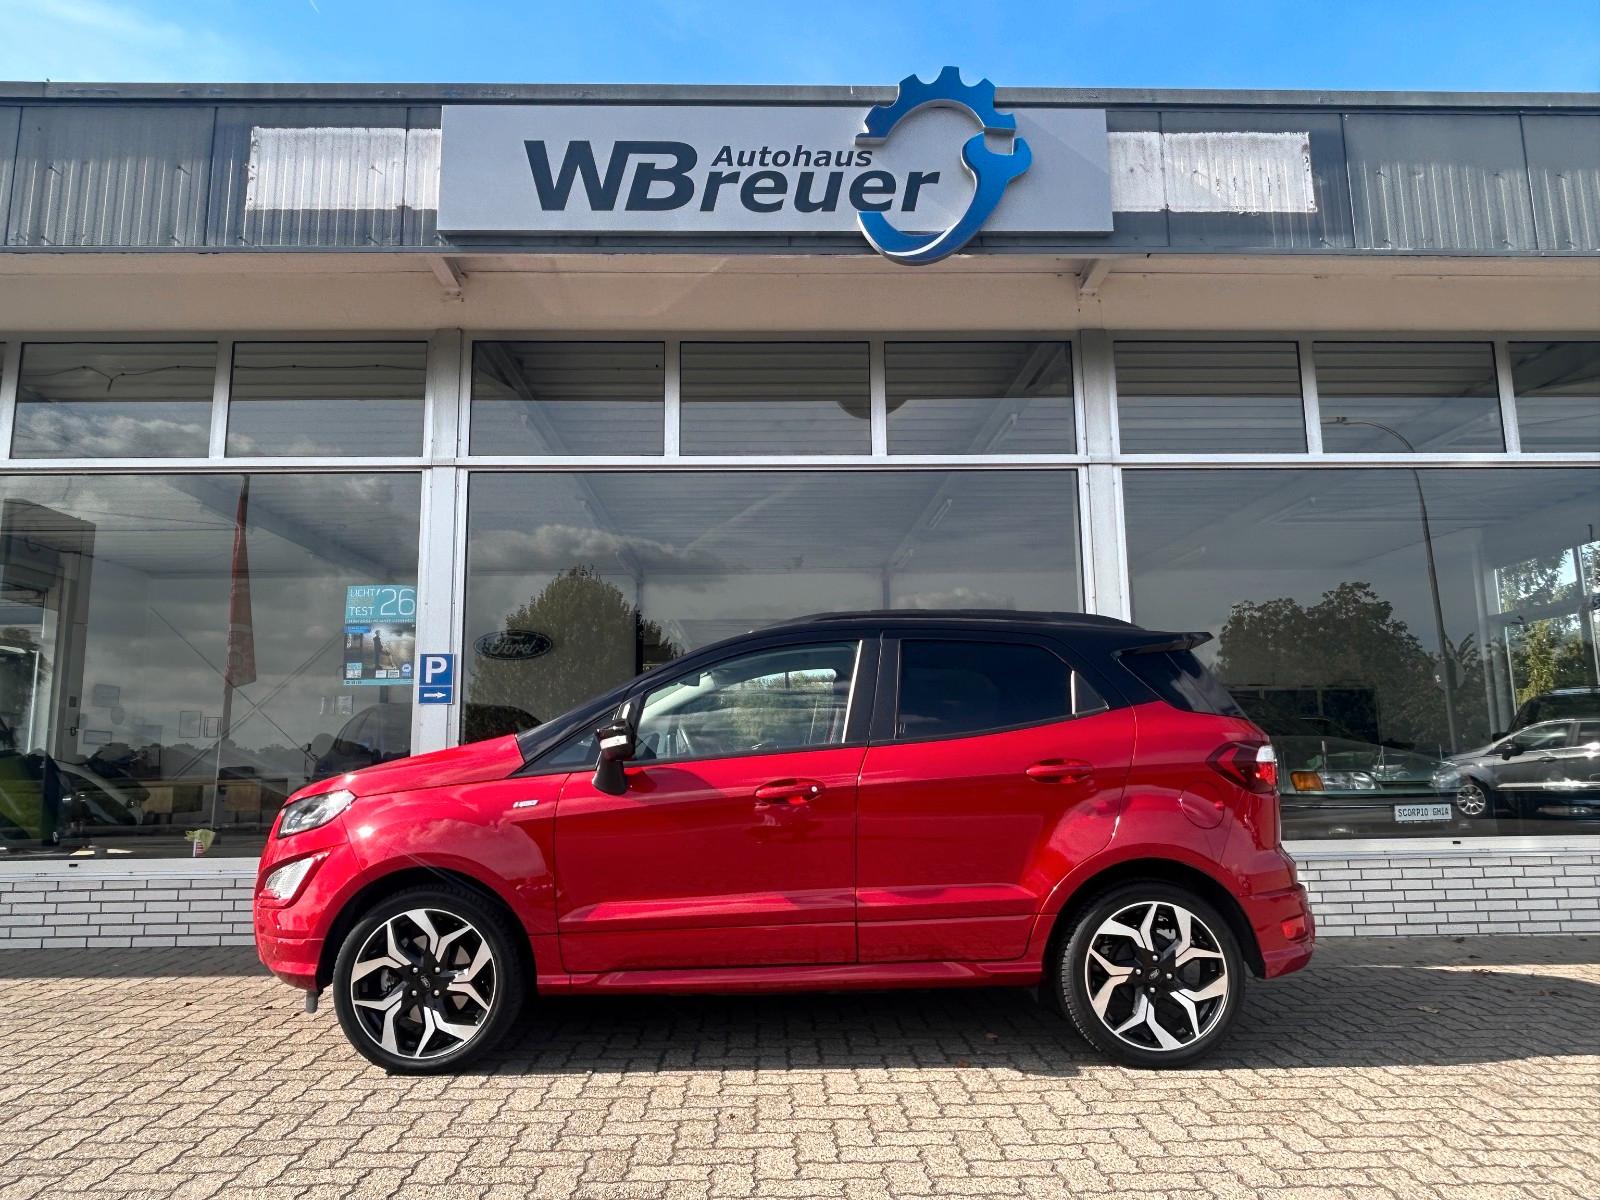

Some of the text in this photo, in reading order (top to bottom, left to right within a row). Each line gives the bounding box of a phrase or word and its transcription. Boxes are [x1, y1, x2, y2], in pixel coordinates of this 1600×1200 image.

[710, 145, 873, 168] Autohaus
[348, 606, 375, 616] TEST
[488, 634, 537, 656] Ford
[425, 656, 448, 684] P
[1398, 807, 1449, 817] SCORPIO GHIA
